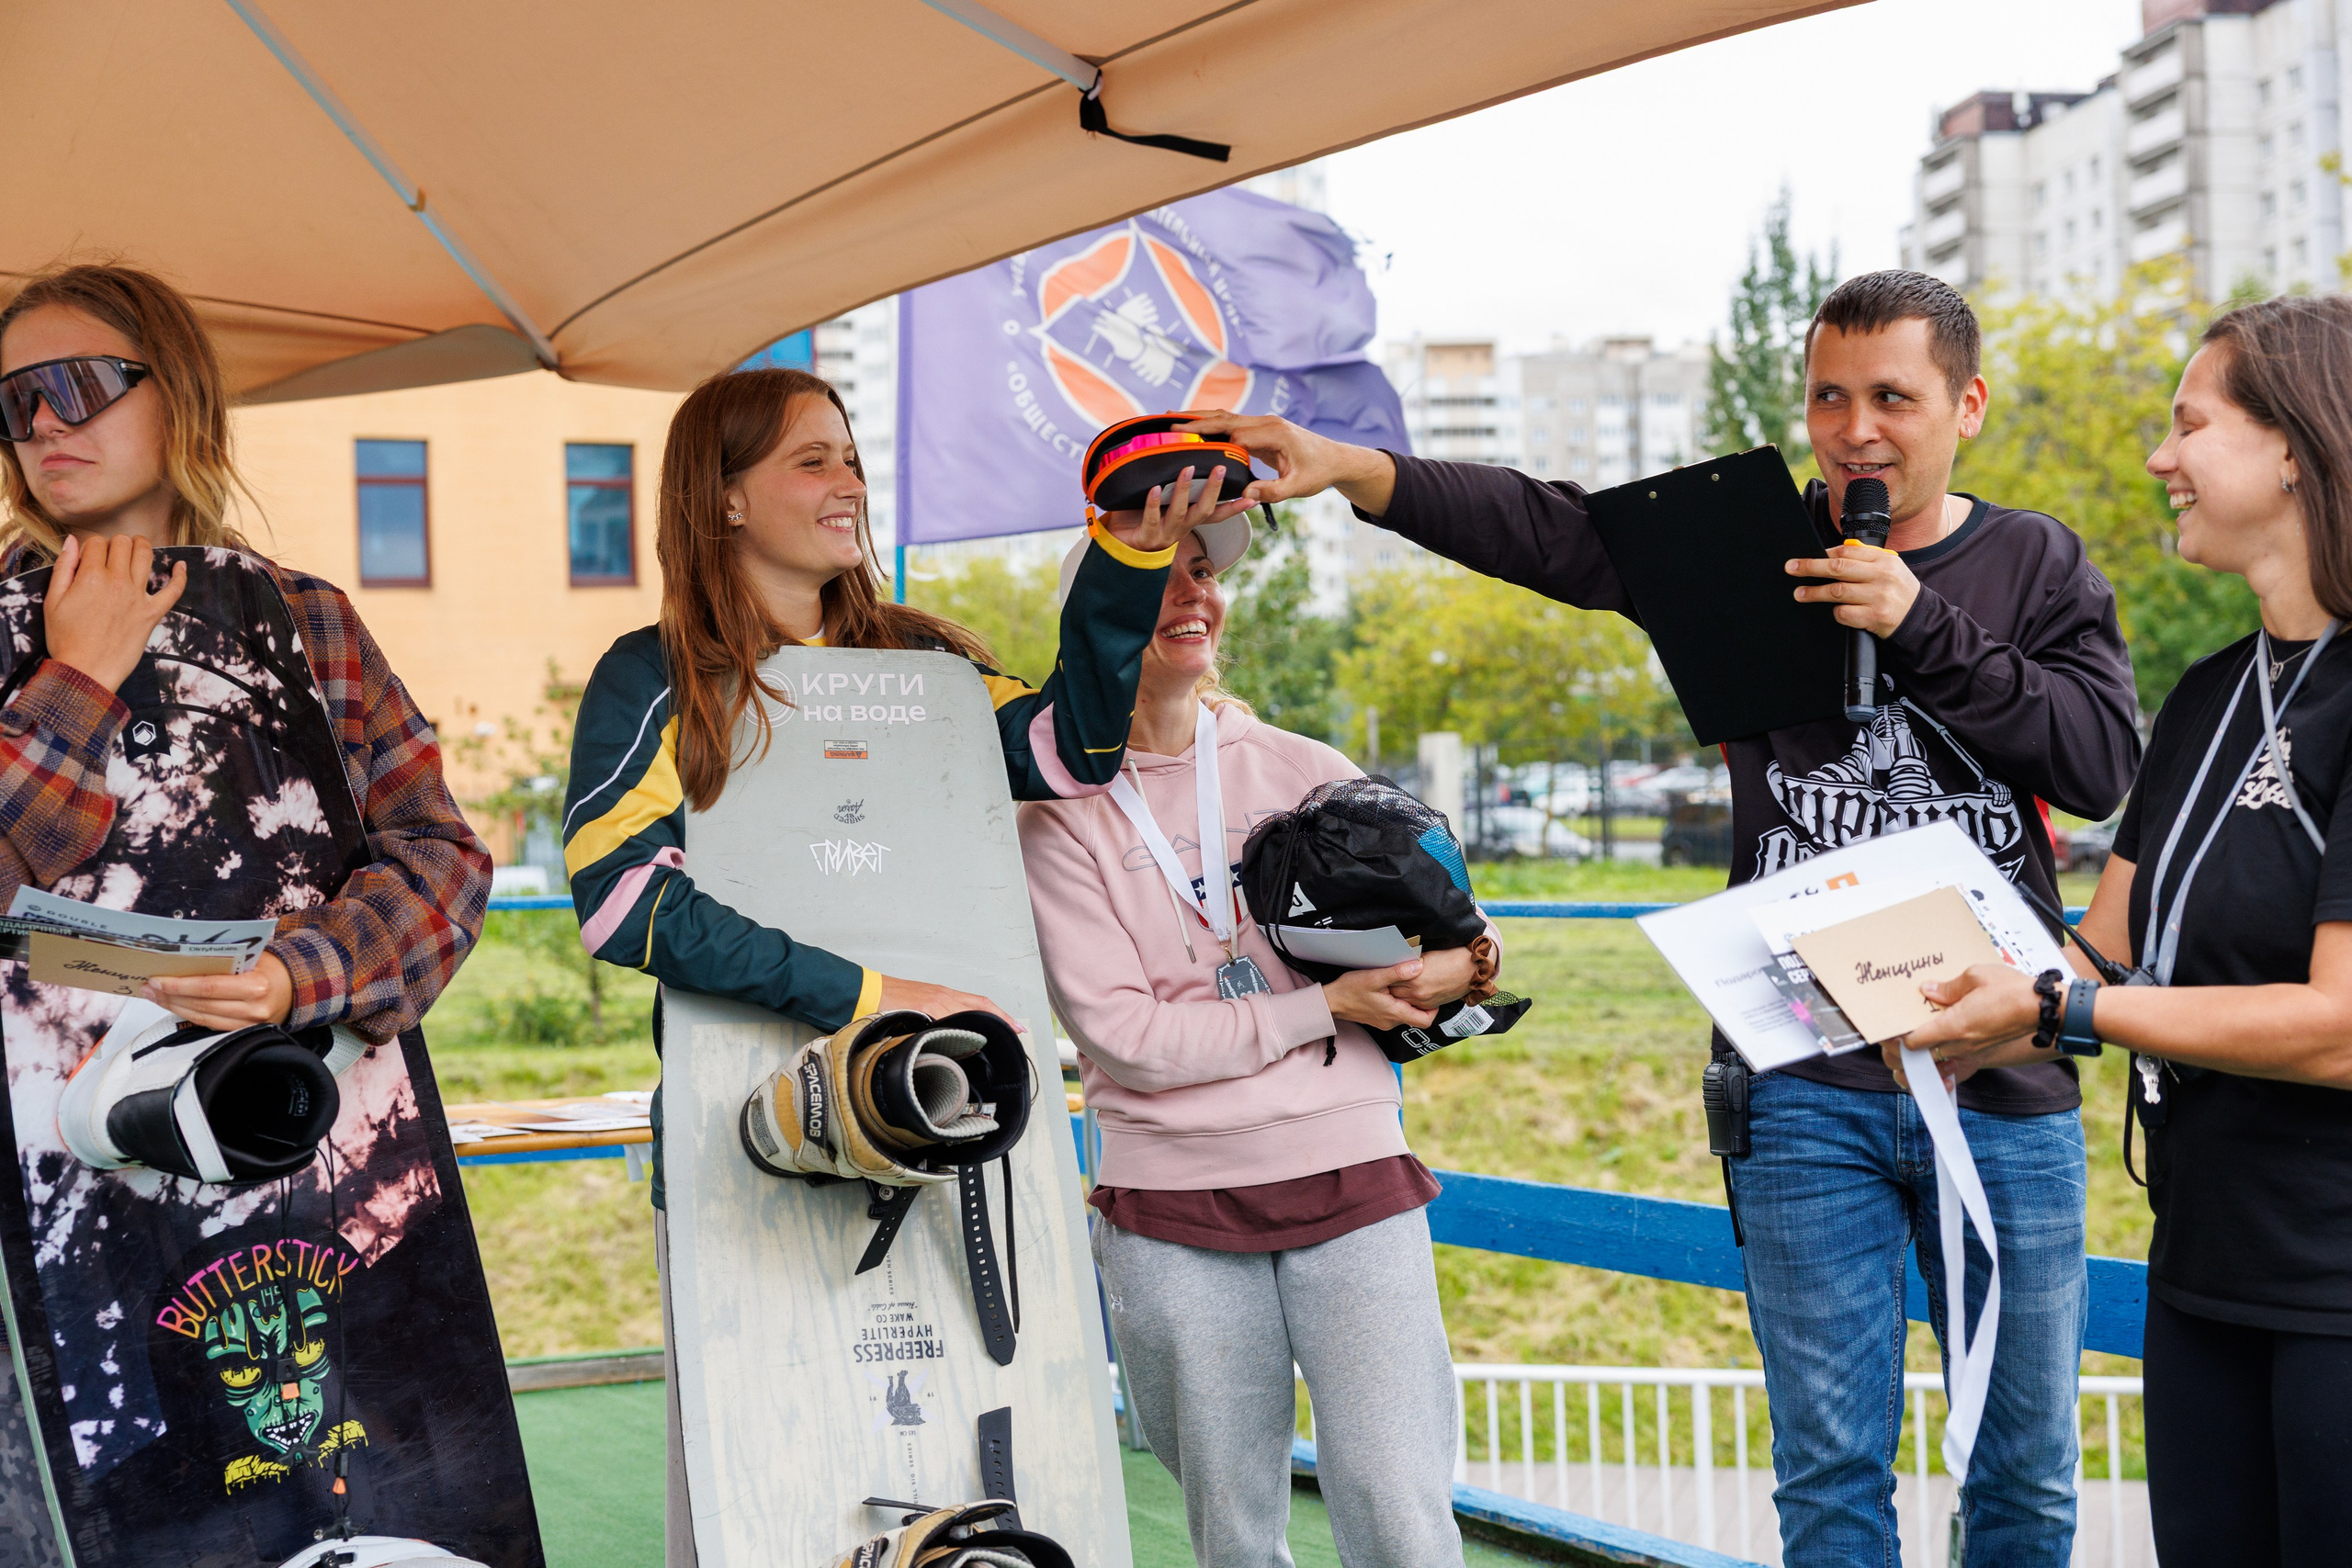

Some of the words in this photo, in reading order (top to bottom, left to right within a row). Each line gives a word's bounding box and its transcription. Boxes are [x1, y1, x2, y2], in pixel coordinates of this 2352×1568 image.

[801, 672, 924, 696] КРУГИ
[803, 705, 842, 722] на
[851, 705, 927, 725] воде
[837, 799, 865, 814] Aaron
[833, 814, 865, 825] SHAPED
[47, 909, 108, 930] DOUBLE
[1855, 952, 1944, 985] Женщины
[803, 1062, 823, 1138] SPACEMOB
[156, 1239, 359, 1339] BUTTERSTICK
[876, 1314, 888, 1324] CO
[889, 1313, 914, 1323] WAKE
[861, 1325, 933, 1341] HYPERLITE
[853, 1339, 944, 1363] FREEPRESS
